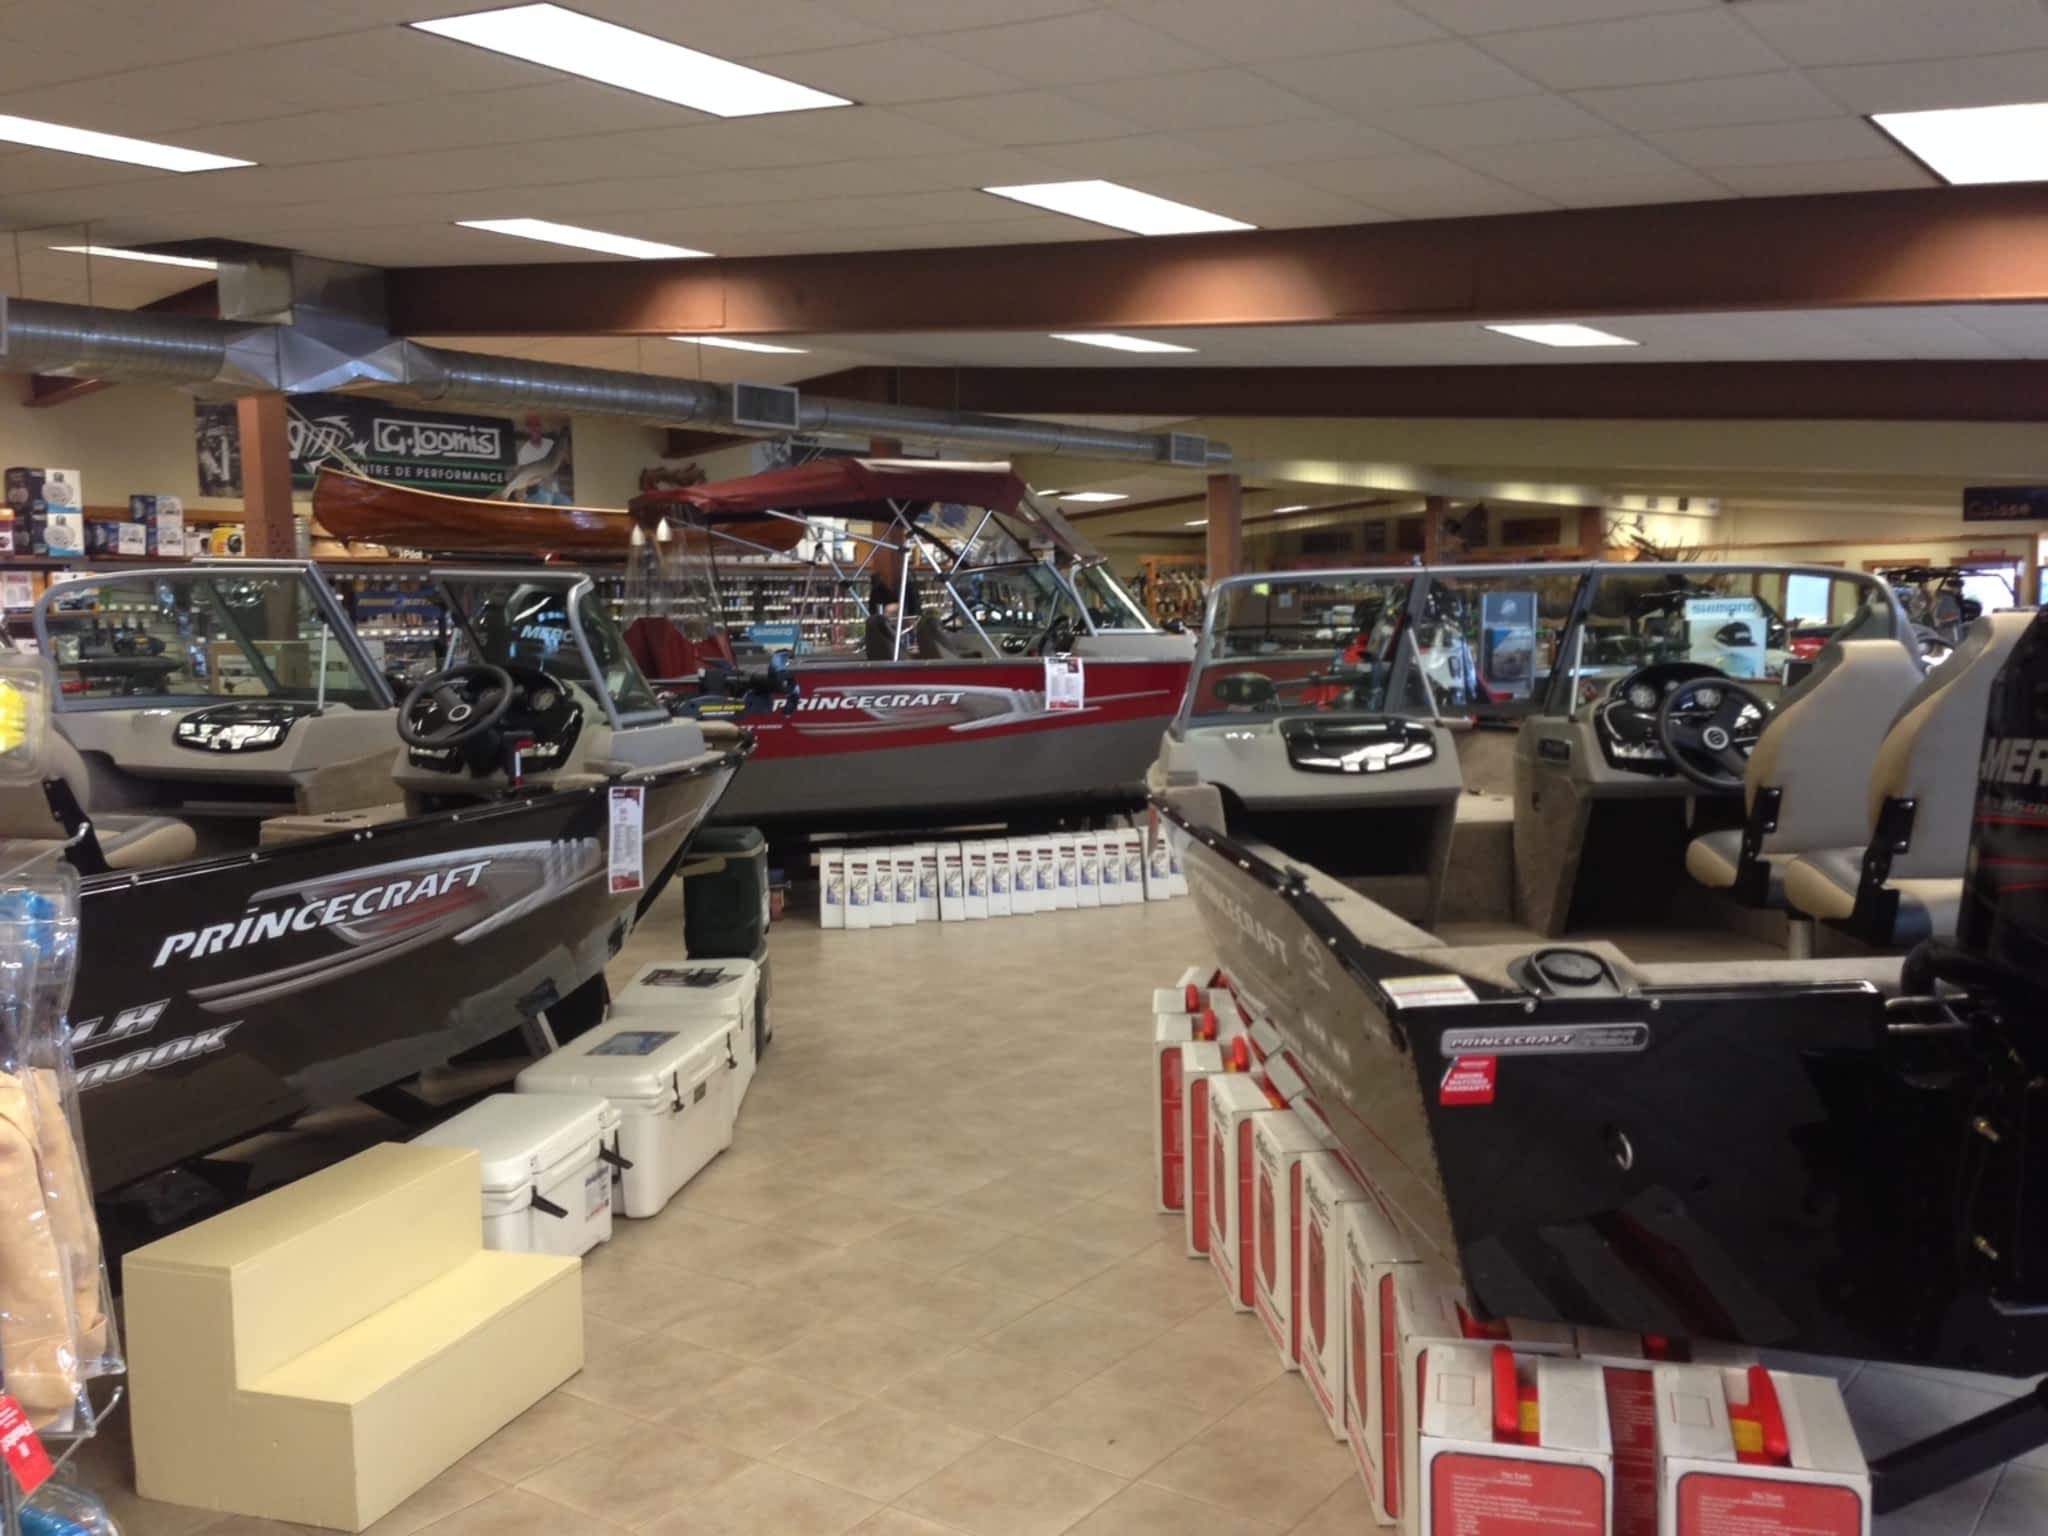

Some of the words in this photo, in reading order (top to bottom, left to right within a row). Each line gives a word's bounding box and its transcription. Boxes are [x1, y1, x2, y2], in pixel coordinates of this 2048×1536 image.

[343, 462, 391, 476] CNTRE
[395, 465, 411, 477] DE
[416, 466, 503, 483] PERFORMANCE
[152, 860, 491, 968] PRINCECRAFT
[1450, 1033, 1576, 1049] PRINCECRAFT
